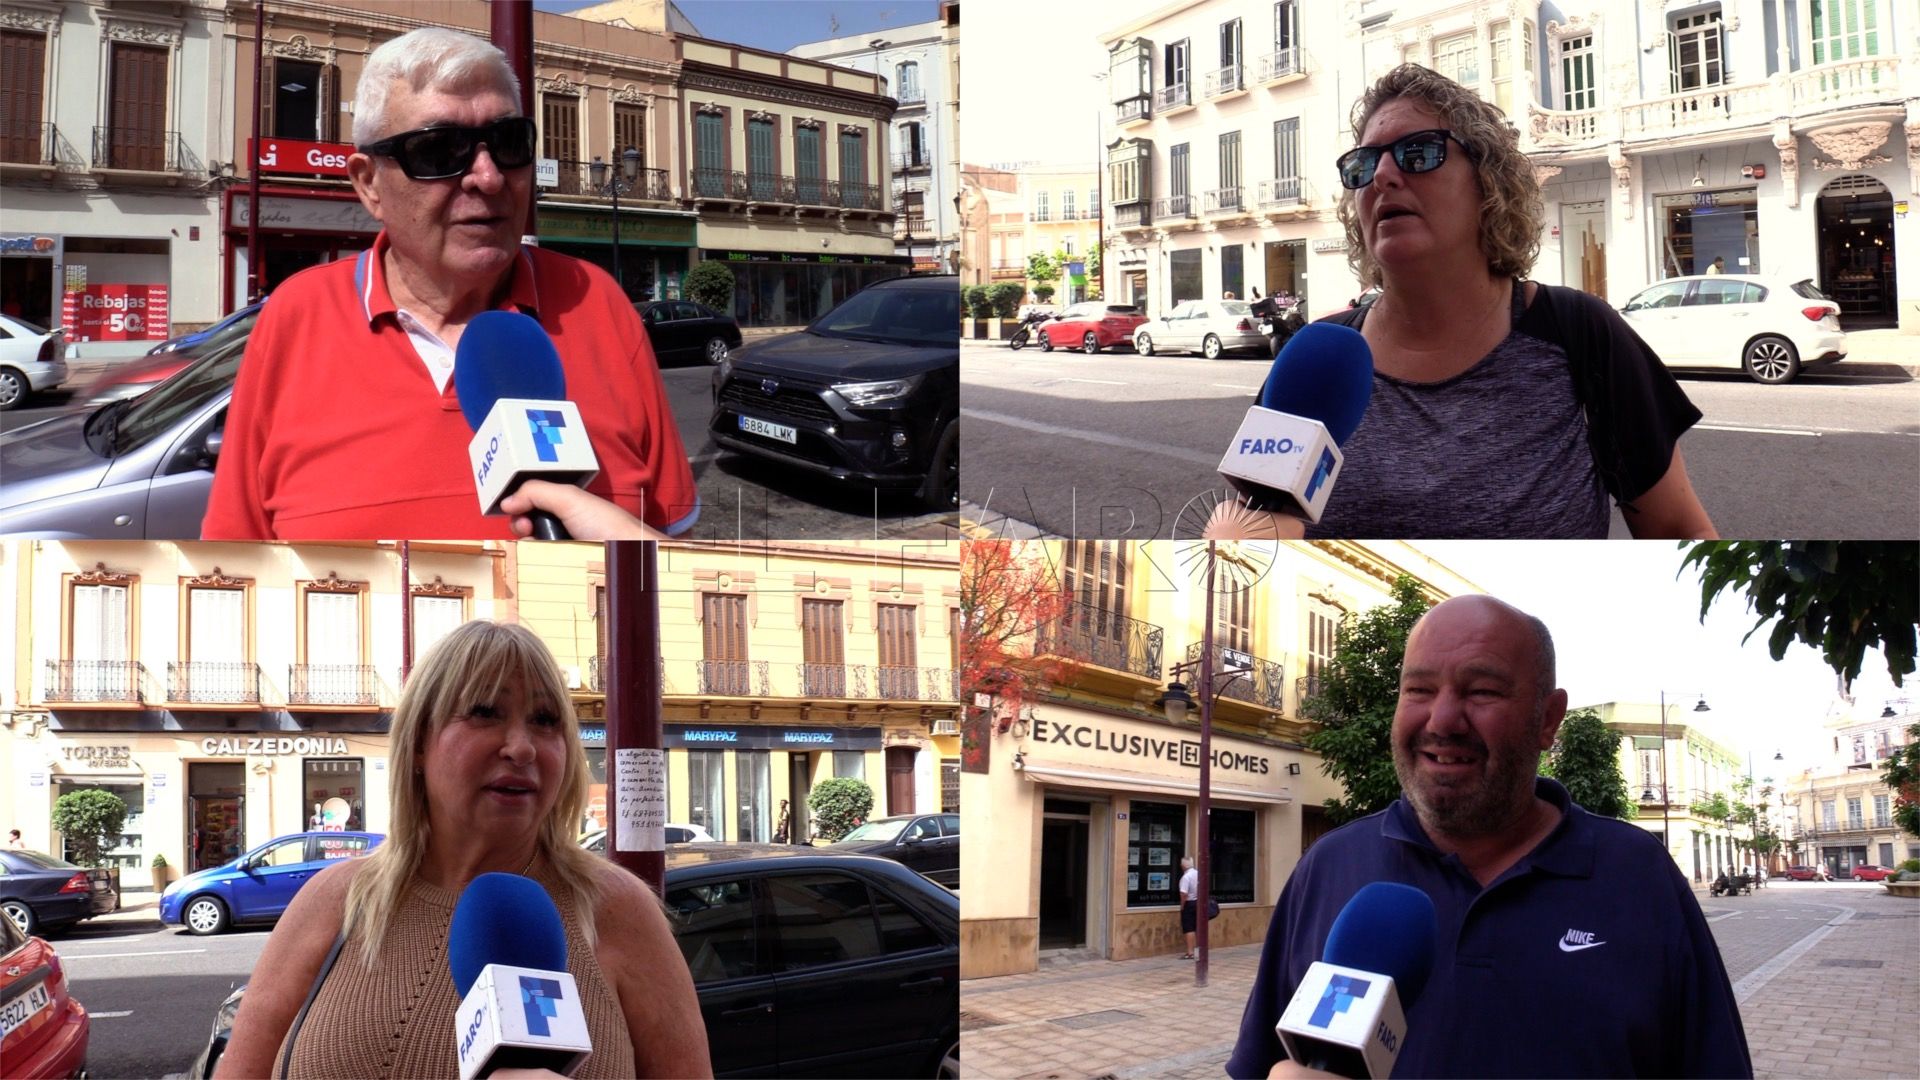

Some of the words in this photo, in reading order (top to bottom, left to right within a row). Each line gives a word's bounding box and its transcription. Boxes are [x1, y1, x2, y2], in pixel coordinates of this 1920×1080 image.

[83, 294, 146, 311] Rebajas
[744, 418, 770, 435] 6884
[1239, 438, 1293, 455] FARO
[478, 436, 498, 487] FARO
[684, 730, 738, 742] MARYPAZ
[784, 731, 834, 743] MARYPAZ
[1032, 719, 1179, 762] EXCLUSIVE
[61, 745, 131, 761] TORRES
[201, 737, 349, 756] CALZEDONIA
[1565, 928, 1596, 945] NIKE
[460, 1008, 483, 1063] FARO
[1377, 1021, 1397, 1053] FARO
